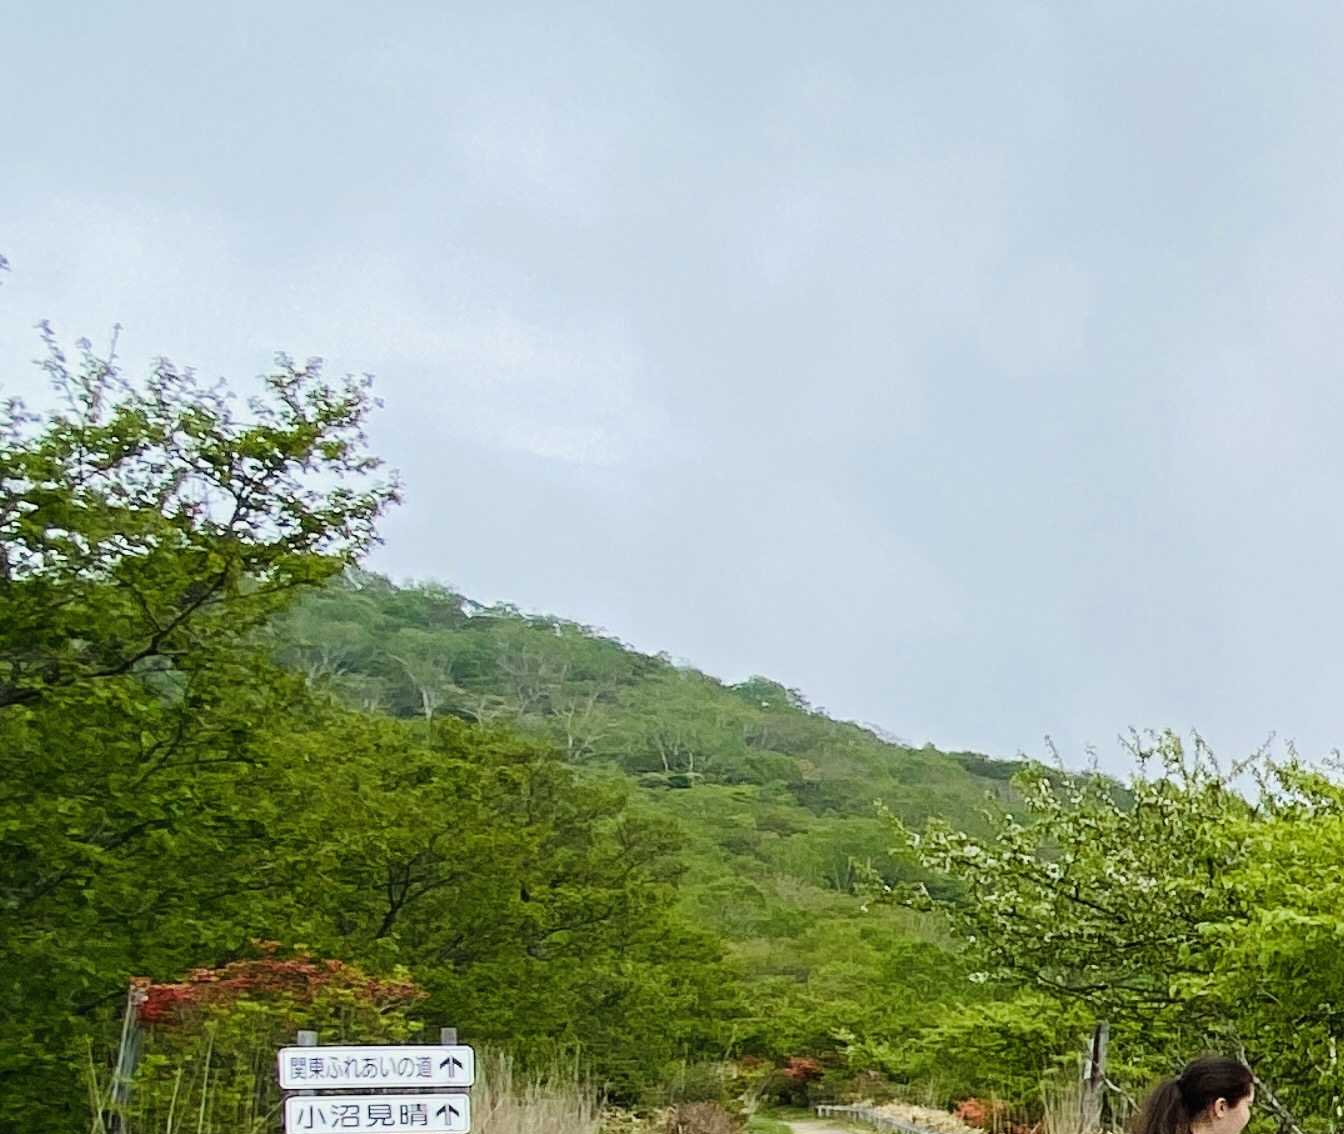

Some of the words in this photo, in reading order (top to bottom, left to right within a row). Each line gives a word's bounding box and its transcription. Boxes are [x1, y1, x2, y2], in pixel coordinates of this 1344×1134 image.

[290, 1056, 432, 1080] 関東ふれあいの道
[297, 1103, 428, 1129] 小沼見晴
